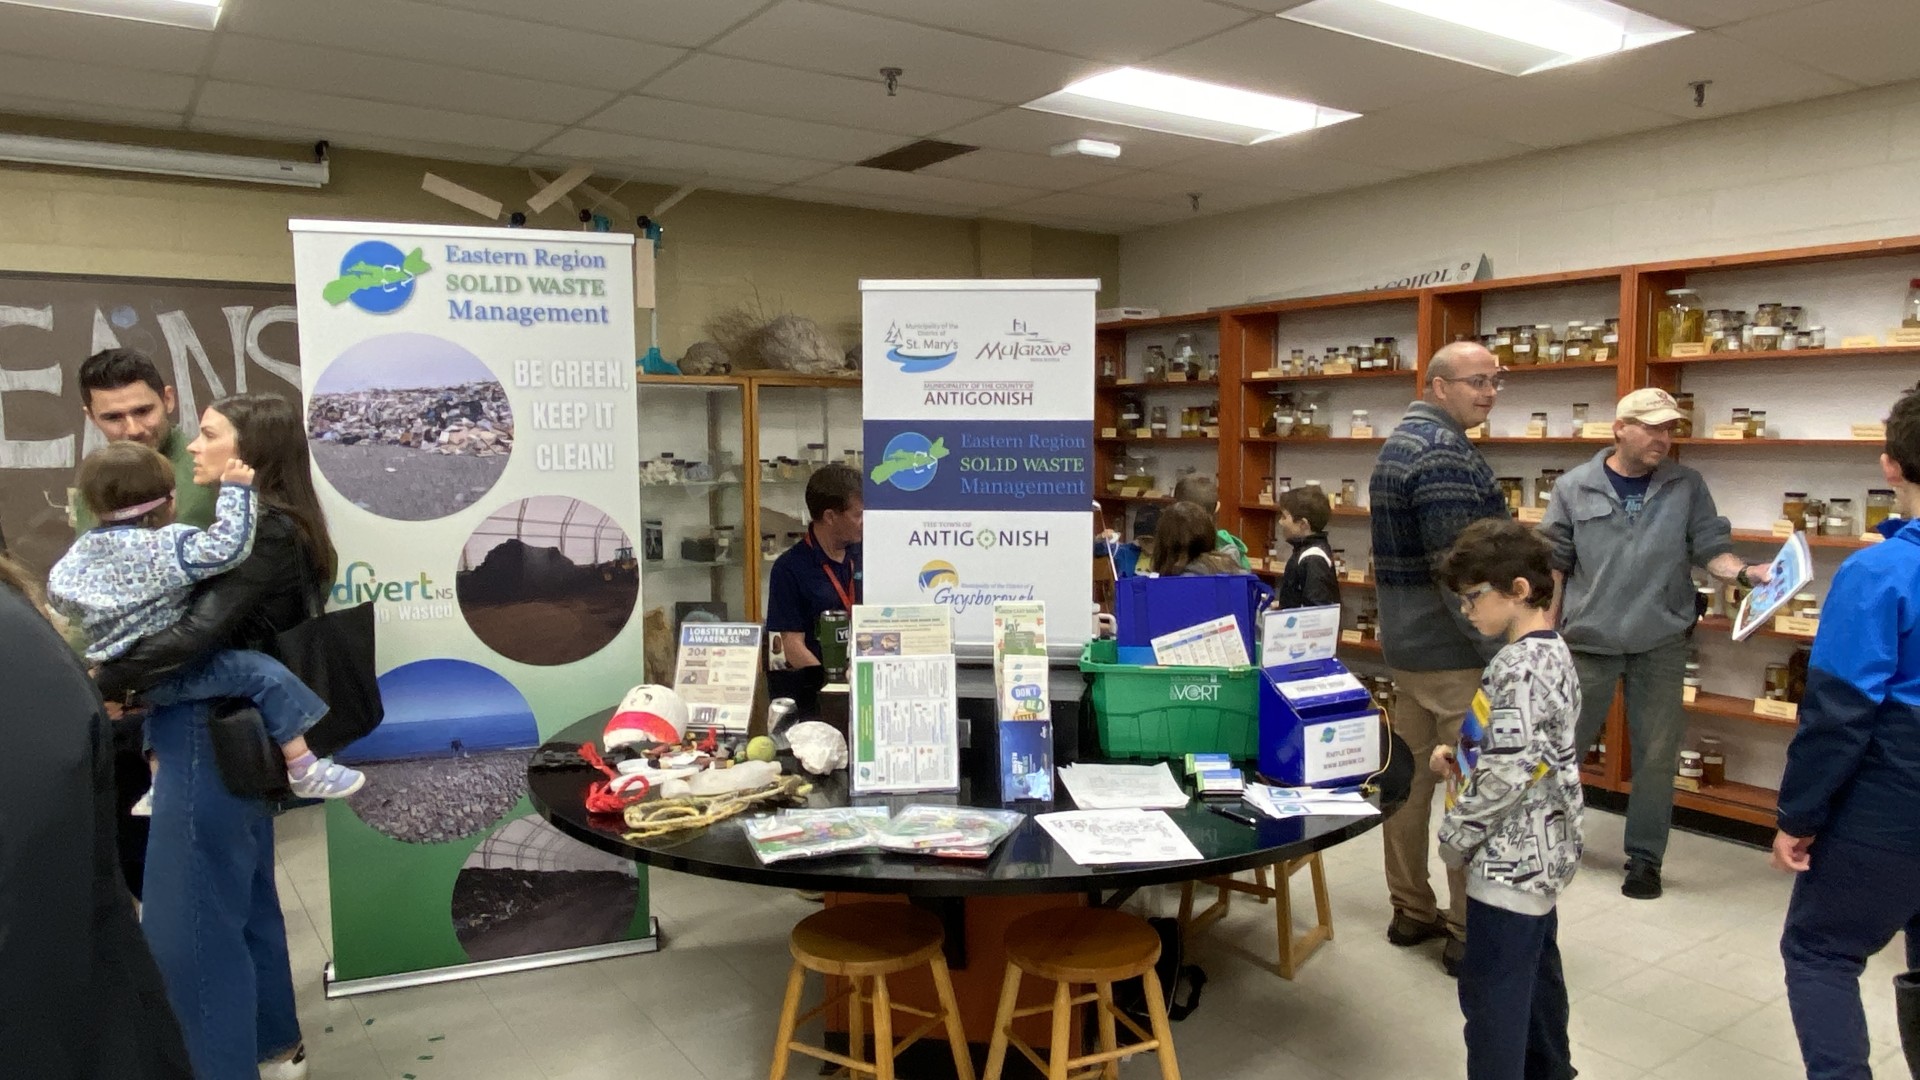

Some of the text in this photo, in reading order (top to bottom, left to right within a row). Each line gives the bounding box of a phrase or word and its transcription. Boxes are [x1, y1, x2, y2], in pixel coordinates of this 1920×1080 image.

[445, 245, 606, 272] Eastern Region
[446, 274, 605, 296] SOLID WASTE
[448, 299, 609, 326] Management
[906, 339, 958, 352] St. Mary's
[514, 360, 629, 392] BE GREEN,
[924, 391, 1033, 406] ANTIGONISH
[532, 402, 614, 429] KEEP IT
[960, 433, 1086, 452] Eastern Region
[537, 443, 614, 471] CLEAN!
[960, 457, 1085, 472] SOLID WASTE
[960, 477, 1086, 499] Management
[688, 636, 740, 644] AWARENESS
[689, 628, 751, 636] LOBSTER BAND
[687, 648, 707, 656] 204
[1015, 686, 1037, 698] DON'T
